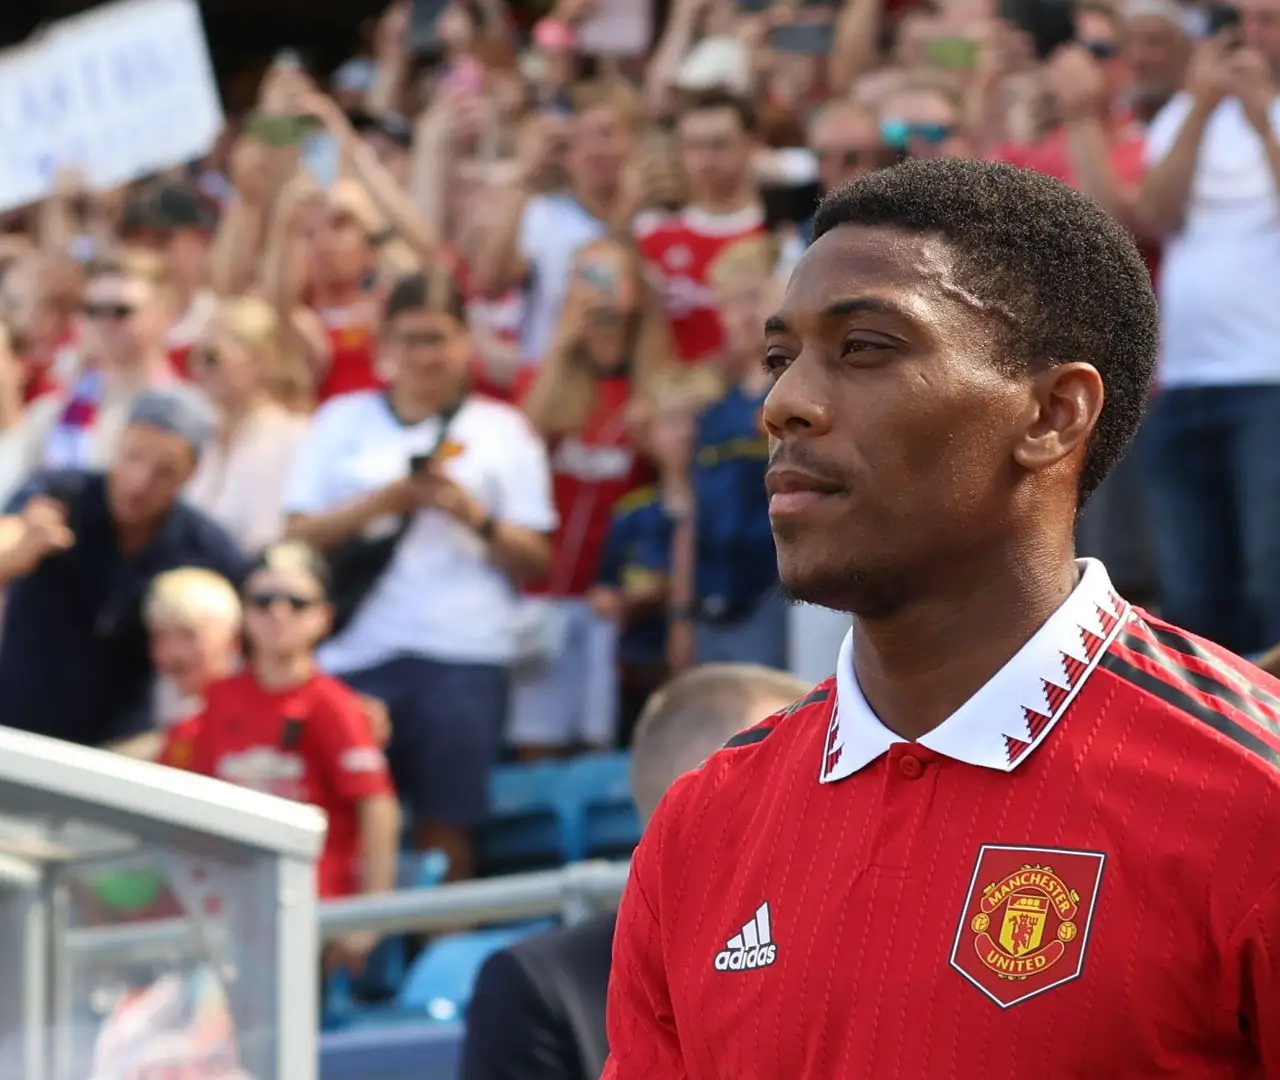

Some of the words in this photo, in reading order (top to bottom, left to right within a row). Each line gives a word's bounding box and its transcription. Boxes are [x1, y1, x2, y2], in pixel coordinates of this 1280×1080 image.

[988, 872, 1071, 913] MANCHESTER
[714, 944, 777, 970] adidas
[986, 950, 1046, 972] UNITED
